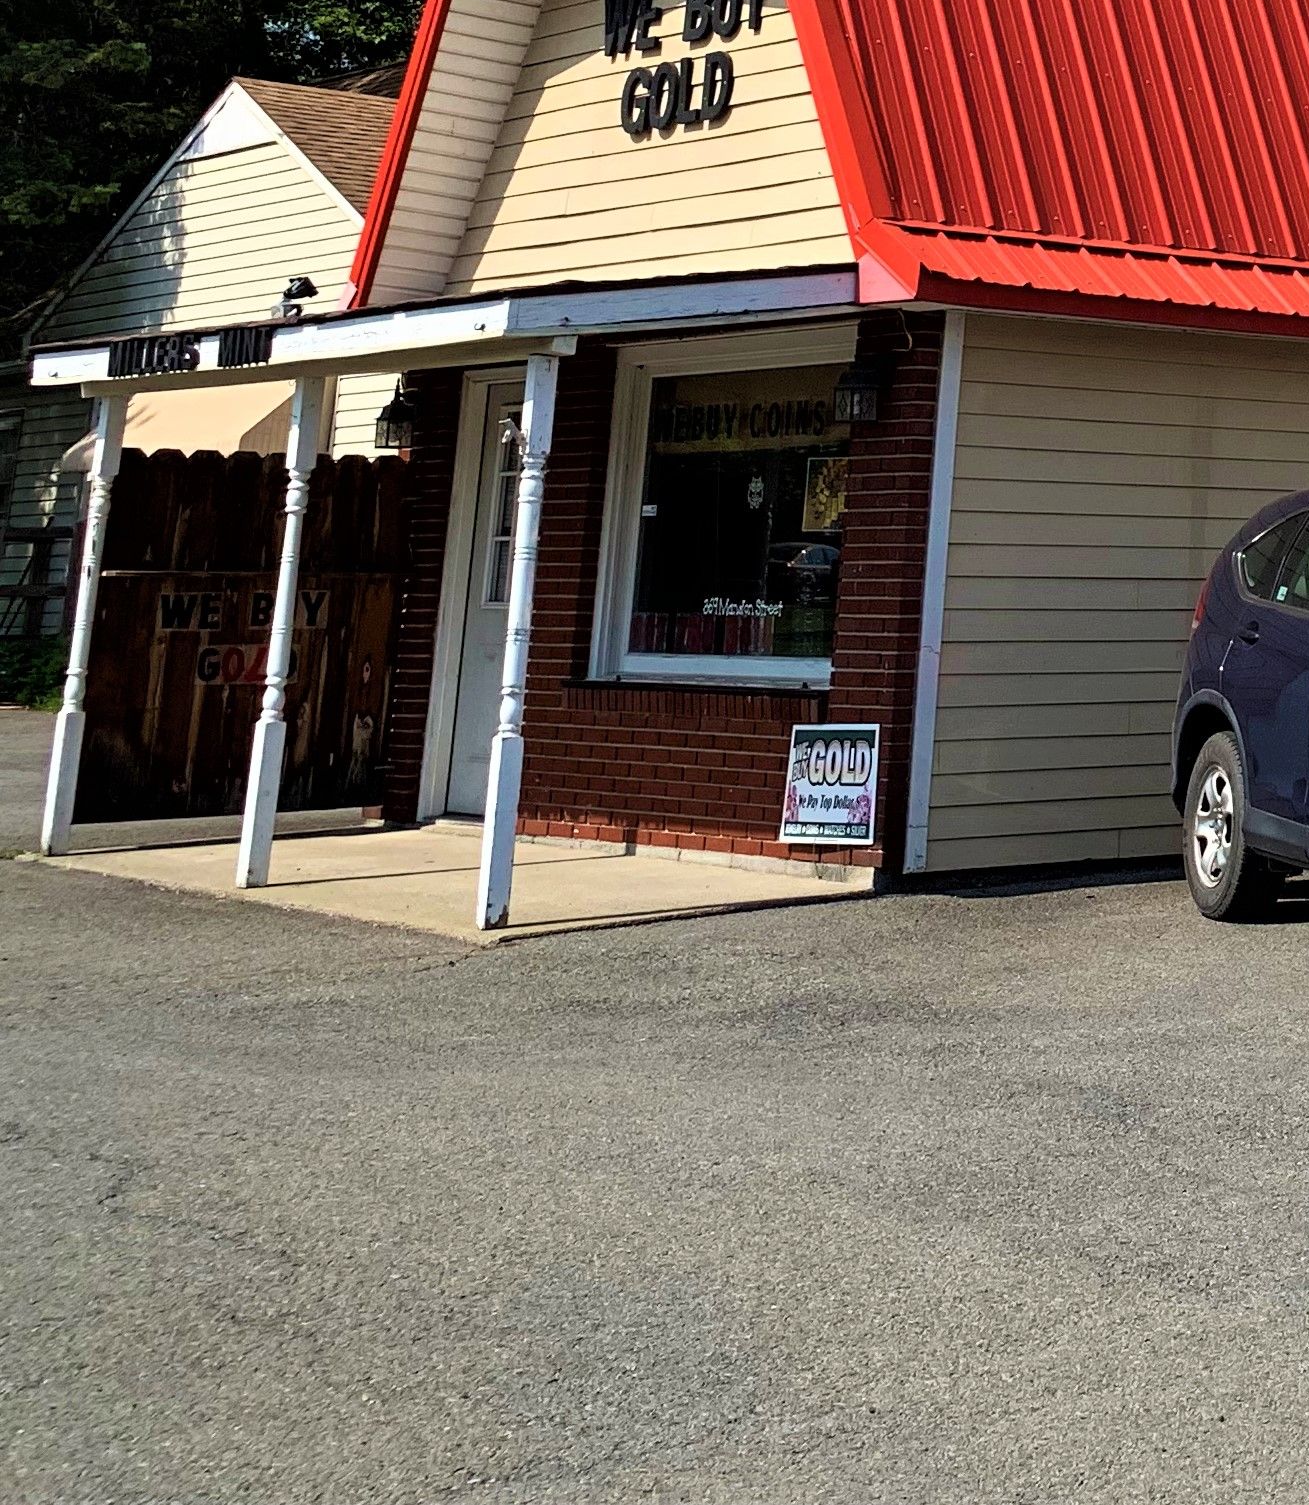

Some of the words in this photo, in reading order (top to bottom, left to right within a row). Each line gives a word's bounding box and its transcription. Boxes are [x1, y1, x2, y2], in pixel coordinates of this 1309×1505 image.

[620, 50, 735, 138] GOLD
[107, 333, 200, 377] MILLERS
[217, 327, 274, 368] MINT
[750, 398, 827, 438] COINS
[160, 594, 222, 630] WE
[251, 591, 328, 627] BY
[755, 598, 784, 618] Street
[792, 759, 809, 783] BUY
[795, 741, 810, 761] WE
[808, 738, 872, 786] GOLD
[806, 794, 819, 811] Pay
[820, 794, 833, 812] Top
